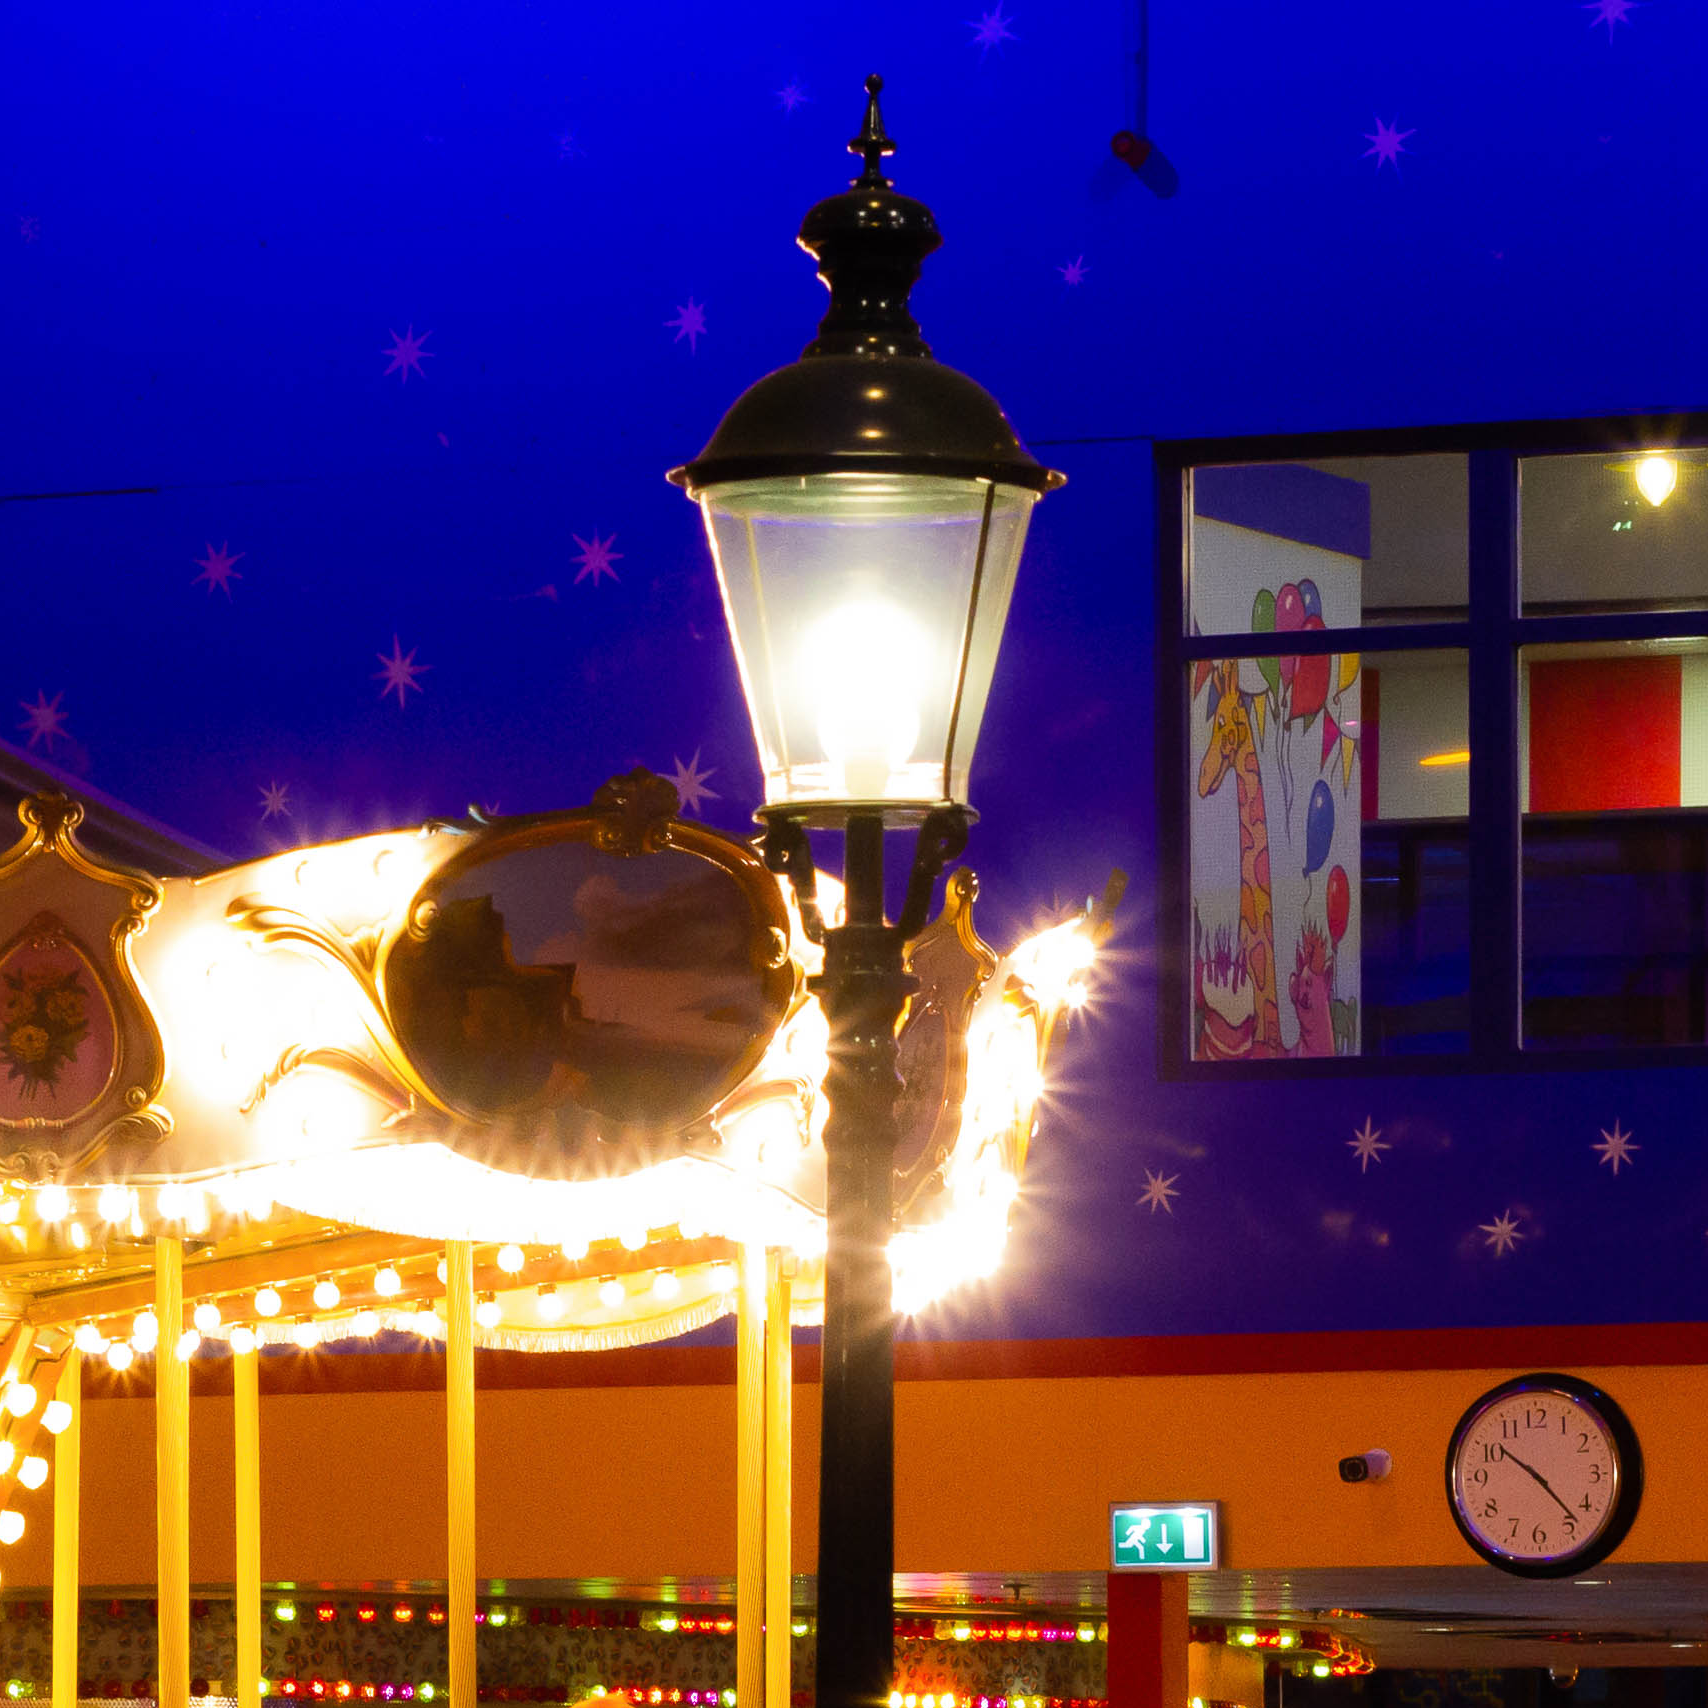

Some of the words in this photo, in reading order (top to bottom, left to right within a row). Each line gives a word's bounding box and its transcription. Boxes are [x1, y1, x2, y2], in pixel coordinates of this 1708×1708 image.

[1502, 1419, 1517, 1438] 11
[1525, 1408, 1547, 1429] 12
[1561, 1415, 1566, 1434] 1
[1484, 1442, 1504, 1463] 10
[1576, 1433, 1590, 1453] 2
[1474, 1468, 1488, 1489] 9
[1589, 1463, 1601, 1484] 3
[1484, 1498, 1498, 1518] 8
[1578, 1492, 1592, 1512] 4
[1508, 1518, 1520, 1538] 7
[1532, 1523, 1547, 1544] 6
[1563, 1515, 1576, 1536] 5
